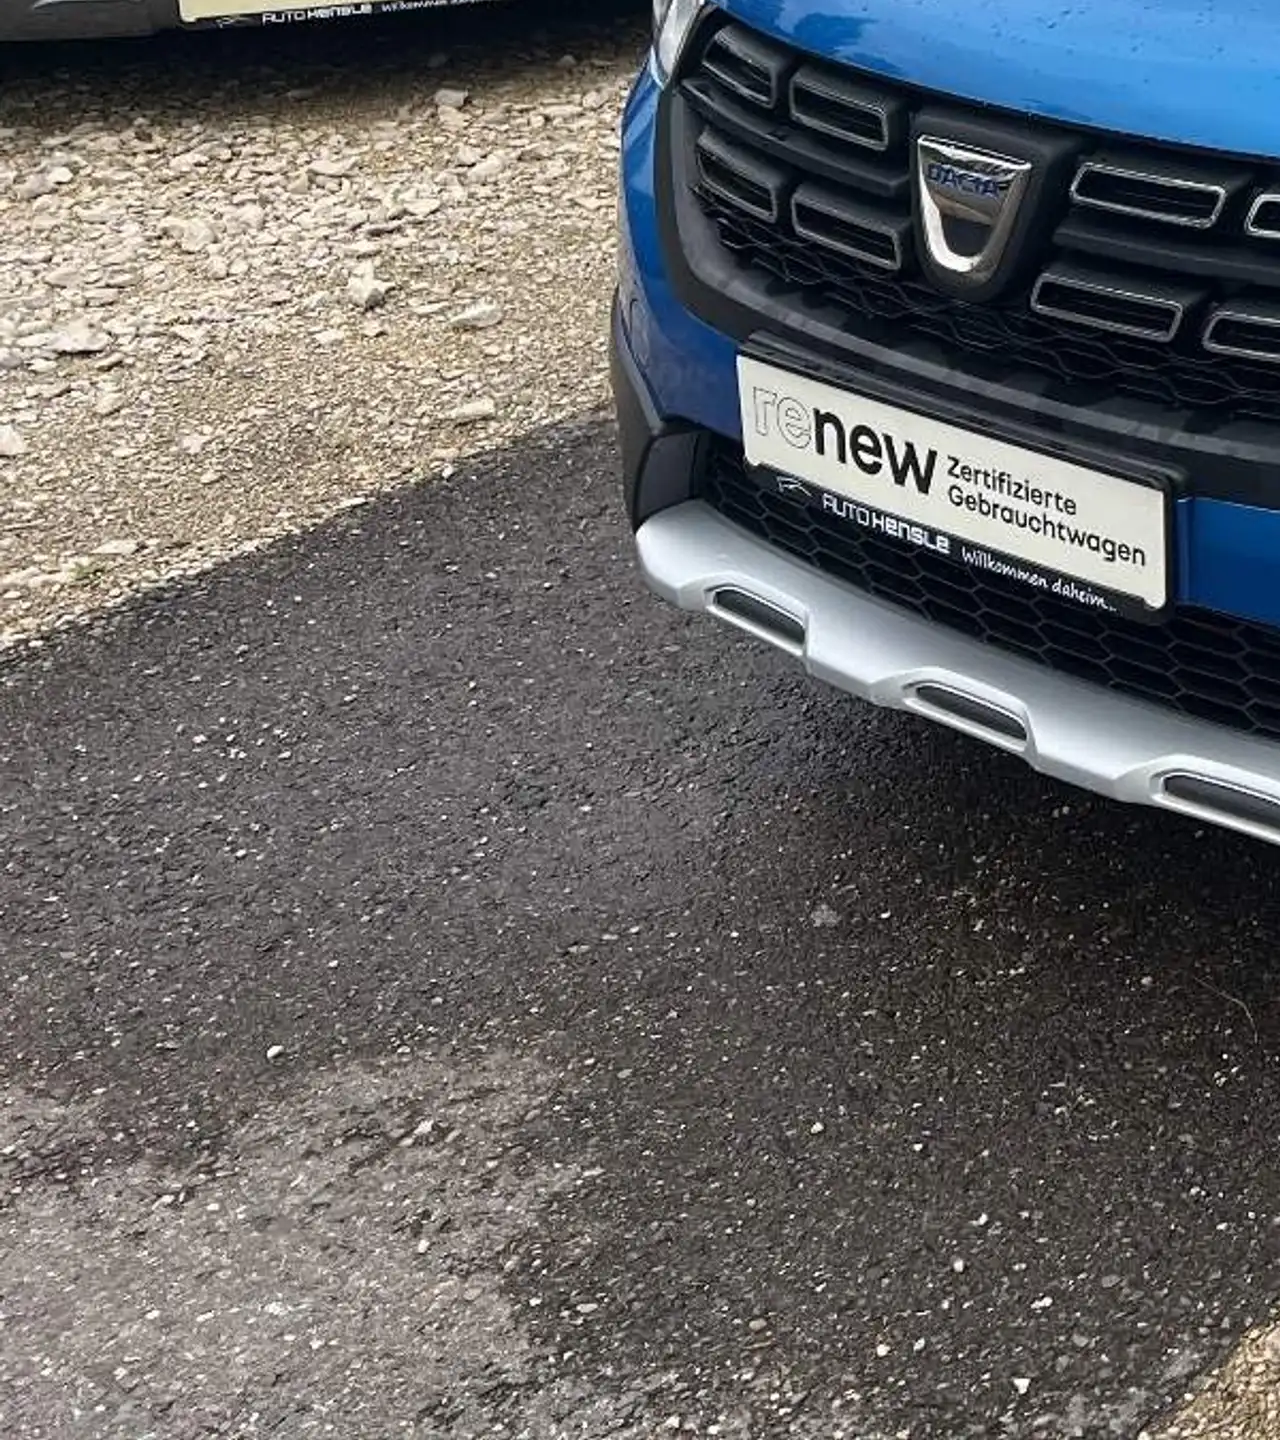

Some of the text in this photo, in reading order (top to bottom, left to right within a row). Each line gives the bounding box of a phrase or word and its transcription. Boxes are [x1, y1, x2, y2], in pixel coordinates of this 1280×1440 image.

[927, 163, 1000, 199] DACIA
[753, 386, 938, 495] renew
[947, 455, 1077, 515] Zertifizierte
[947, 484, 1147, 567] Gebrauchtwagen
[961, 546, 1049, 590] Willkommen
